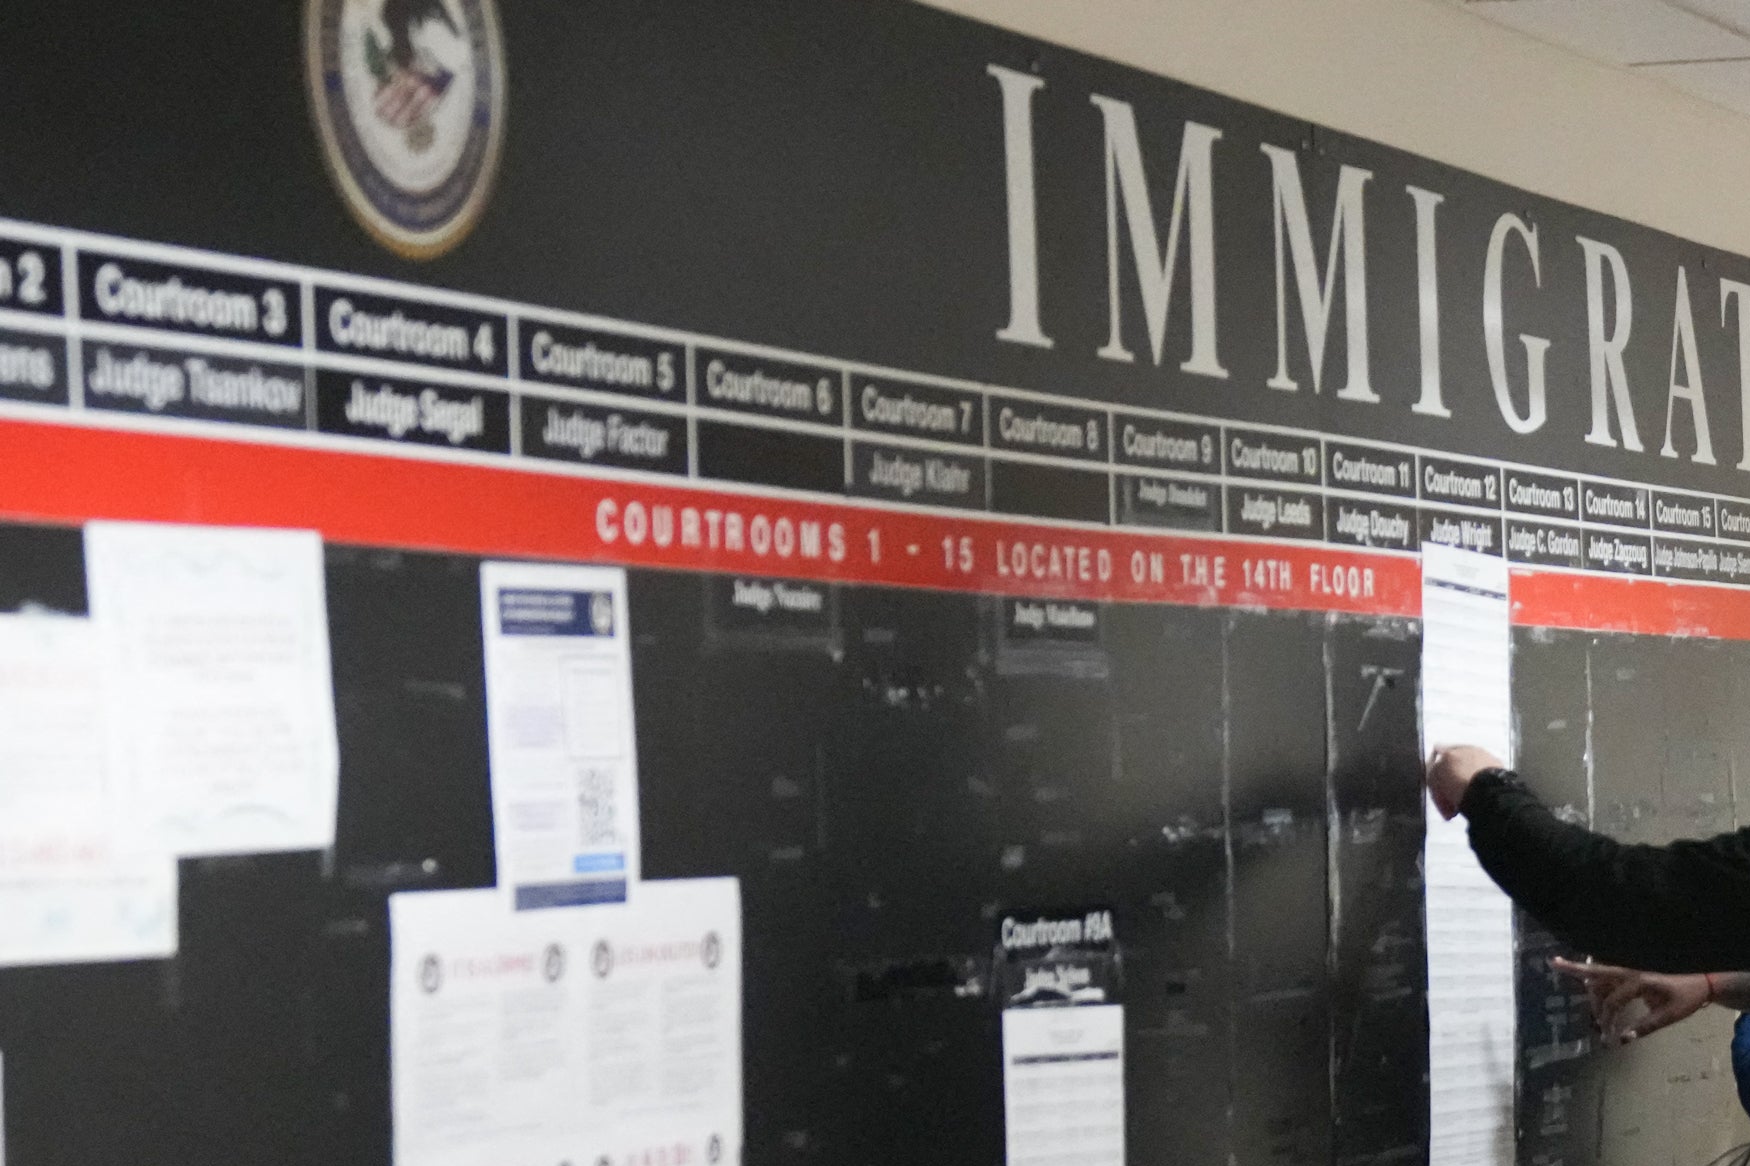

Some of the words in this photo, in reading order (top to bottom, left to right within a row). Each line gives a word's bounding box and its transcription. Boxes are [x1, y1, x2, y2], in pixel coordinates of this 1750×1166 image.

[17, 251, 46, 304] 2
[95, 263, 258, 331] Courtroom
[262, 287, 287, 336] 3
[329, 298, 469, 361] Courtroom
[473, 323, 495, 364] 4
[89, 348, 185, 411] Judge
[532, 331, 652, 386] Courtroom
[657, 352, 674, 391] 5
[707, 359, 813, 411] Courtroom
[816, 377, 832, 415] 6
[345, 379, 418, 438] Judge
[419, 388, 483, 444] Segal
[862, 384, 956, 431] Courtroom
[959, 400, 972, 434] 7
[543, 406, 605, 459] Judge
[606, 413, 669, 458] Factor
[1001, 407, 1083, 448] Courtroom
[1087, 419, 1098, 451] 8
[1123, 424, 1197, 461] Courtroom
[1201, 434, 1212, 464] 9
[869, 451, 923, 497] Judge
[1231, 438, 1299, 474] Courtroom
[1303, 447, 1317, 476] 10
[1333, 451, 1394, 486] Courtroom
[1399, 461, 1410, 488] 11
[1425, 465, 1481, 498] Courtroom
[1484, 474, 1497, 500] 12
[1509, 478, 1560, 509] Courtroom
[1563, 487, 1574, 512] 13
[1241, 493, 1276, 530] Judge
[1337, 506, 1369, 541] Judge
[1586, 490, 1633, 517] Courtroom
[1636, 498, 1646, 520] 14
[1656, 499, 1699, 527] Courtroom
[1702, 506, 1711, 529] 15
[596, 498, 845, 562] COURTROOMS
[868, 528, 881, 565] 1
[942, 535, 973, 574] 15
[996, 540, 1111, 583] LOCATED
[1131, 550, 1164, 584] ON
[1181, 554, 1226, 588] THE
[1242, 558, 1292, 591] 14TH
[1310, 563, 1374, 598] FLOOR
[1431, 517, 1460, 547] Judge
[1461, 520, 1492, 552] Wright
[1509, 527, 1536, 557] Judge
[1537, 530, 1546, 553] C.
[1548, 530, 1579, 556] Gordon
[1589, 535, 1612, 566] Judge
[1656, 544, 1673, 572] Judge
[1001, 916, 1082, 948] Courtroom
